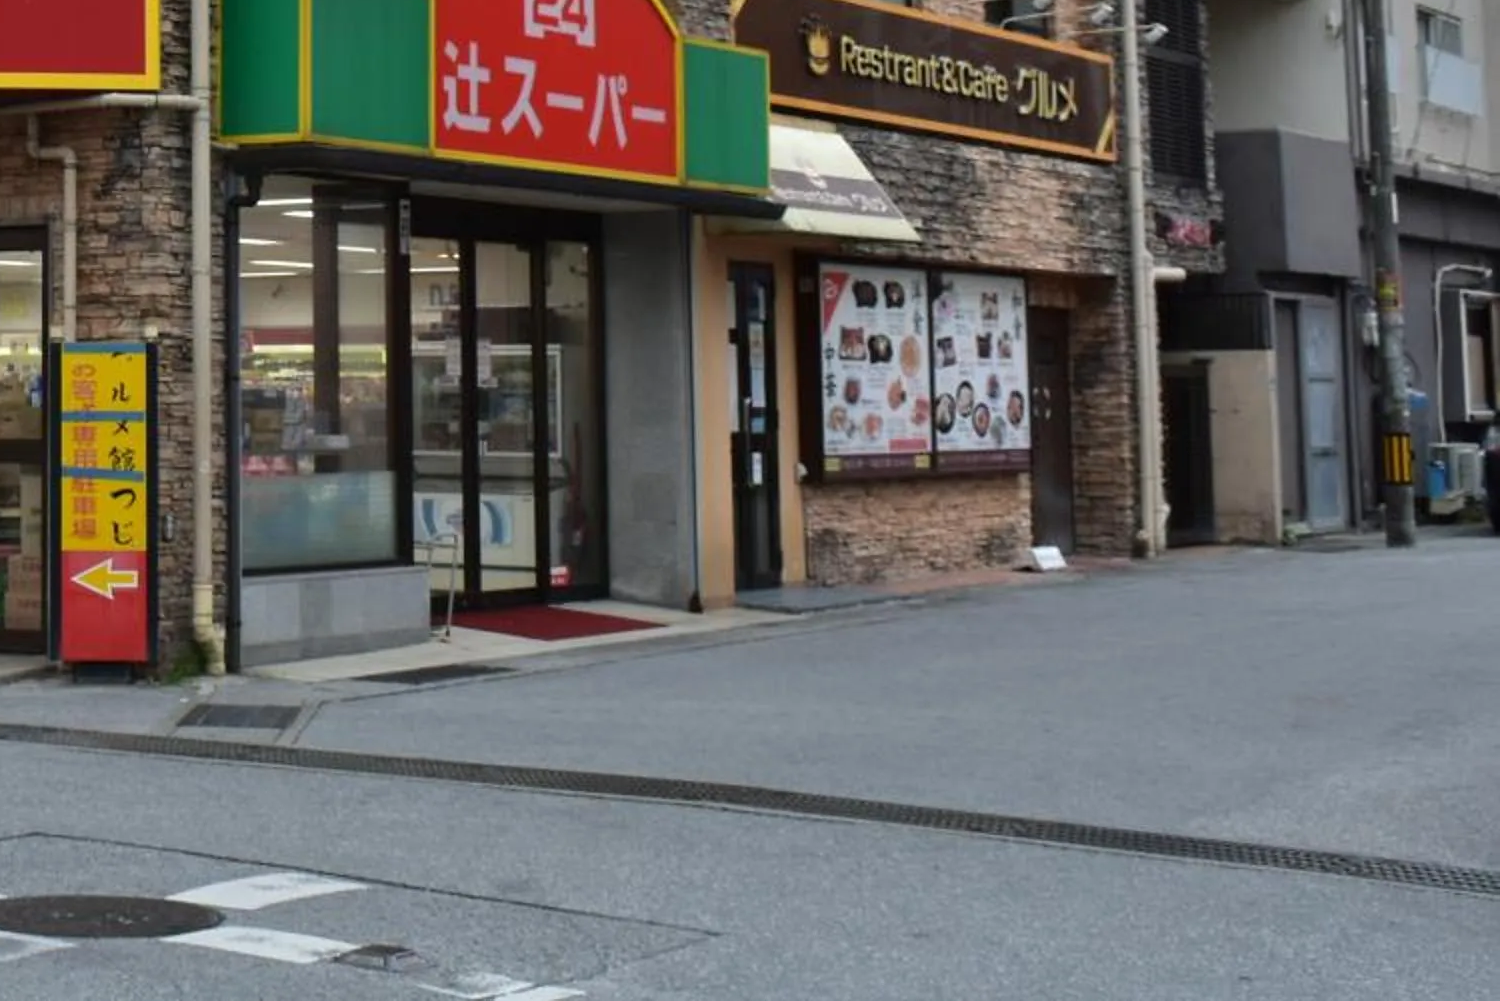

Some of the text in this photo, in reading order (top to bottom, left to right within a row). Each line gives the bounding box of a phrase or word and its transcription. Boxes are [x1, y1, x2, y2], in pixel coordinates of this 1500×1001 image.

[443, 41, 667, 150] 辻スーパー
[840, 34, 1079, 122] Restrant&Cafe グルメ
